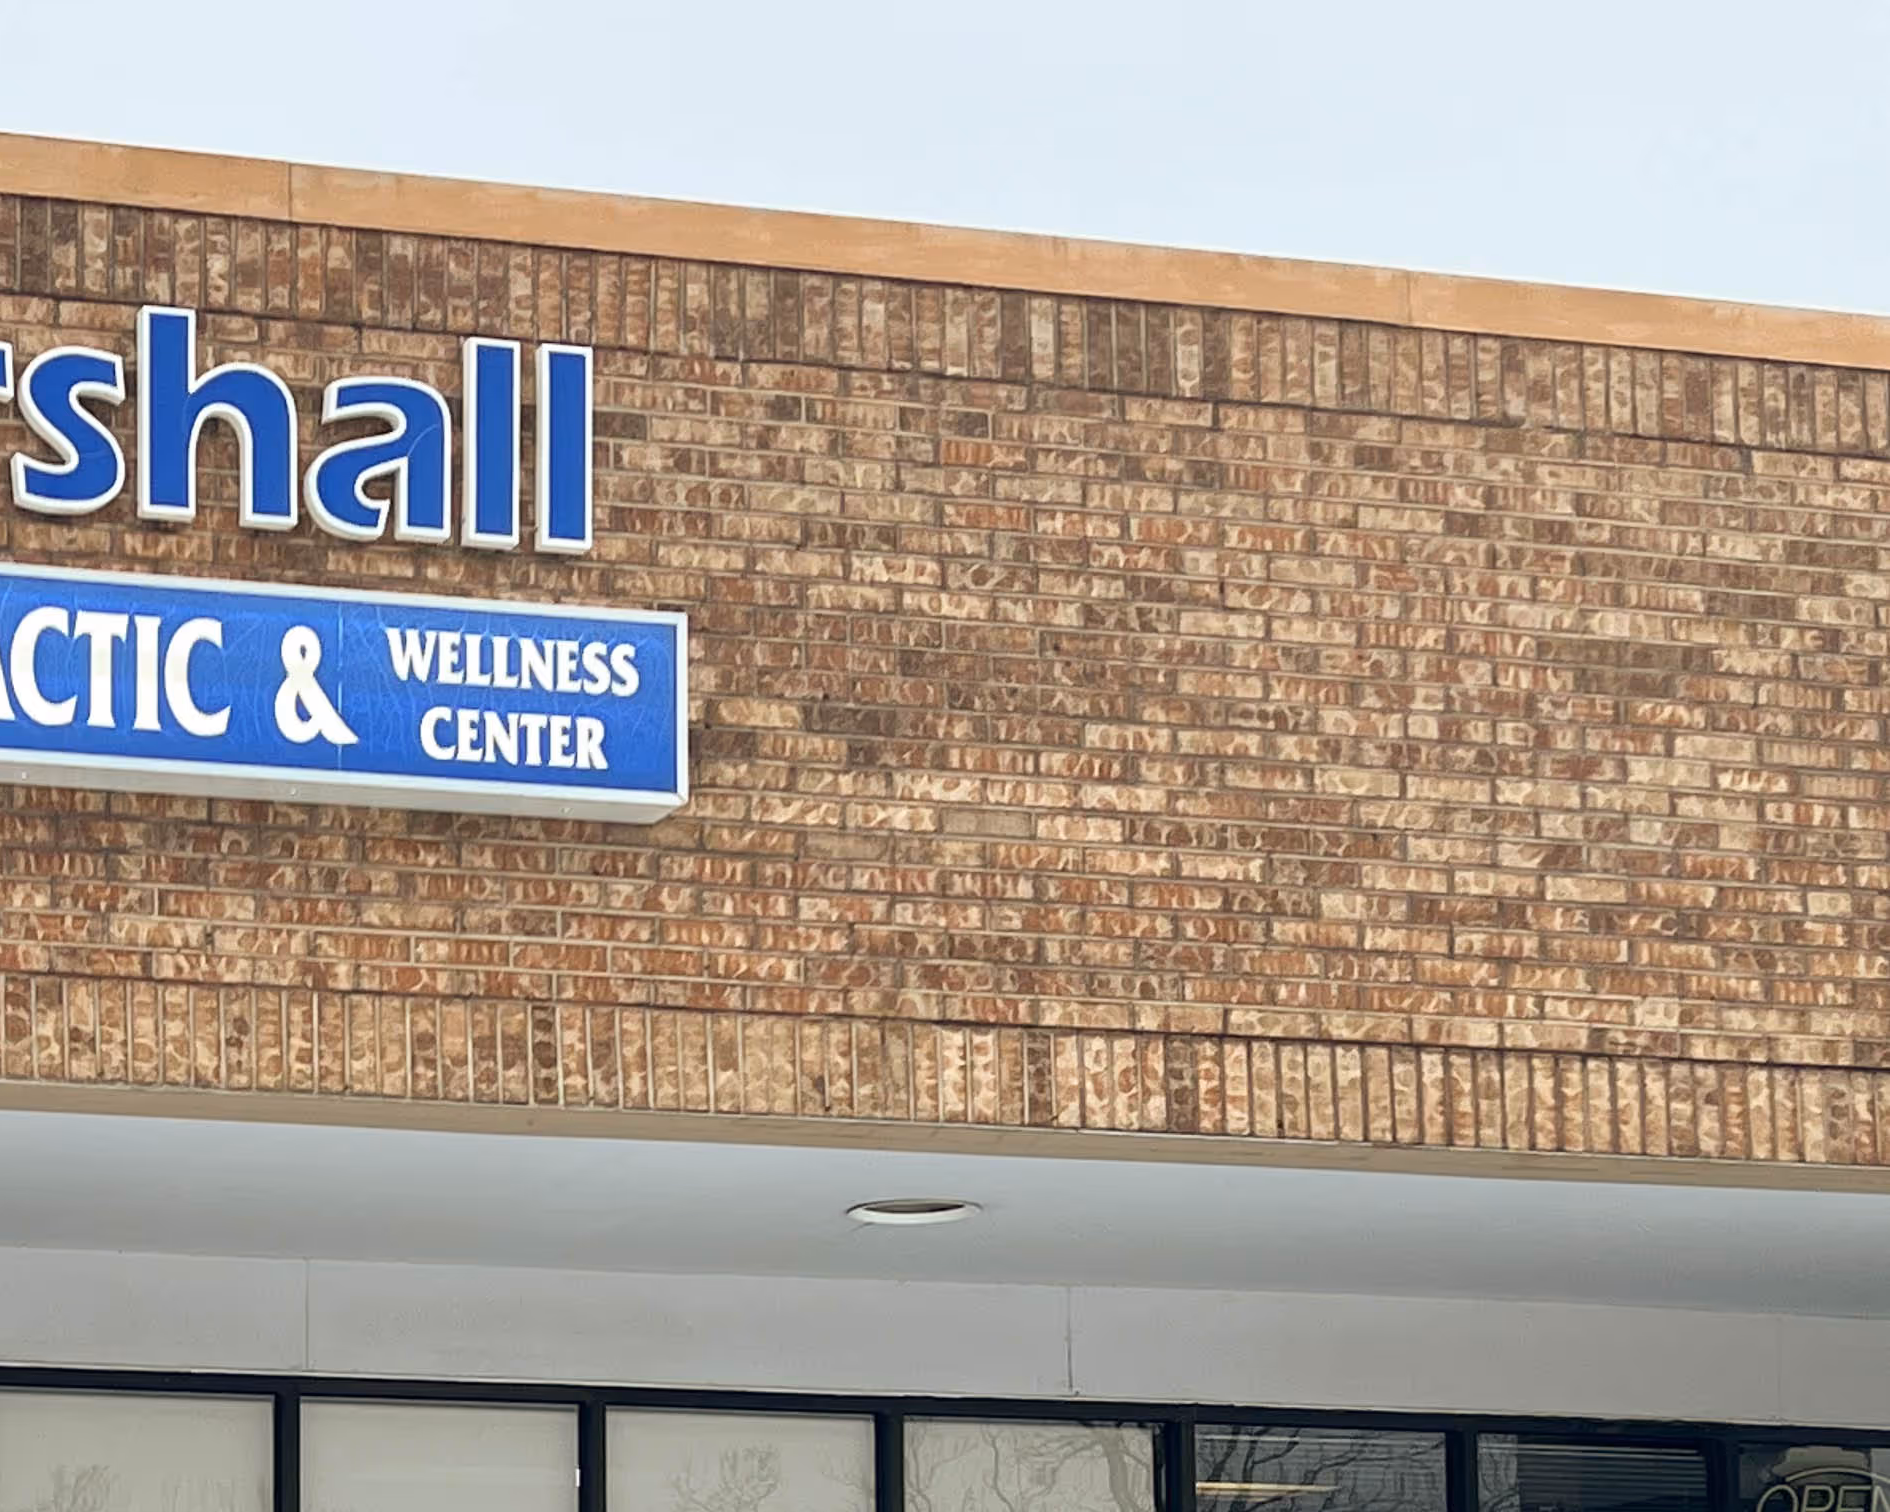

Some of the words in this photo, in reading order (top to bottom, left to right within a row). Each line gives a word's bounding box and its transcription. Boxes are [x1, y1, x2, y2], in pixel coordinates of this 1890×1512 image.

[275, 625, 359, 747] &
[386, 626, 641, 698] WELLNESS
[421, 707, 609, 771] CENTER
